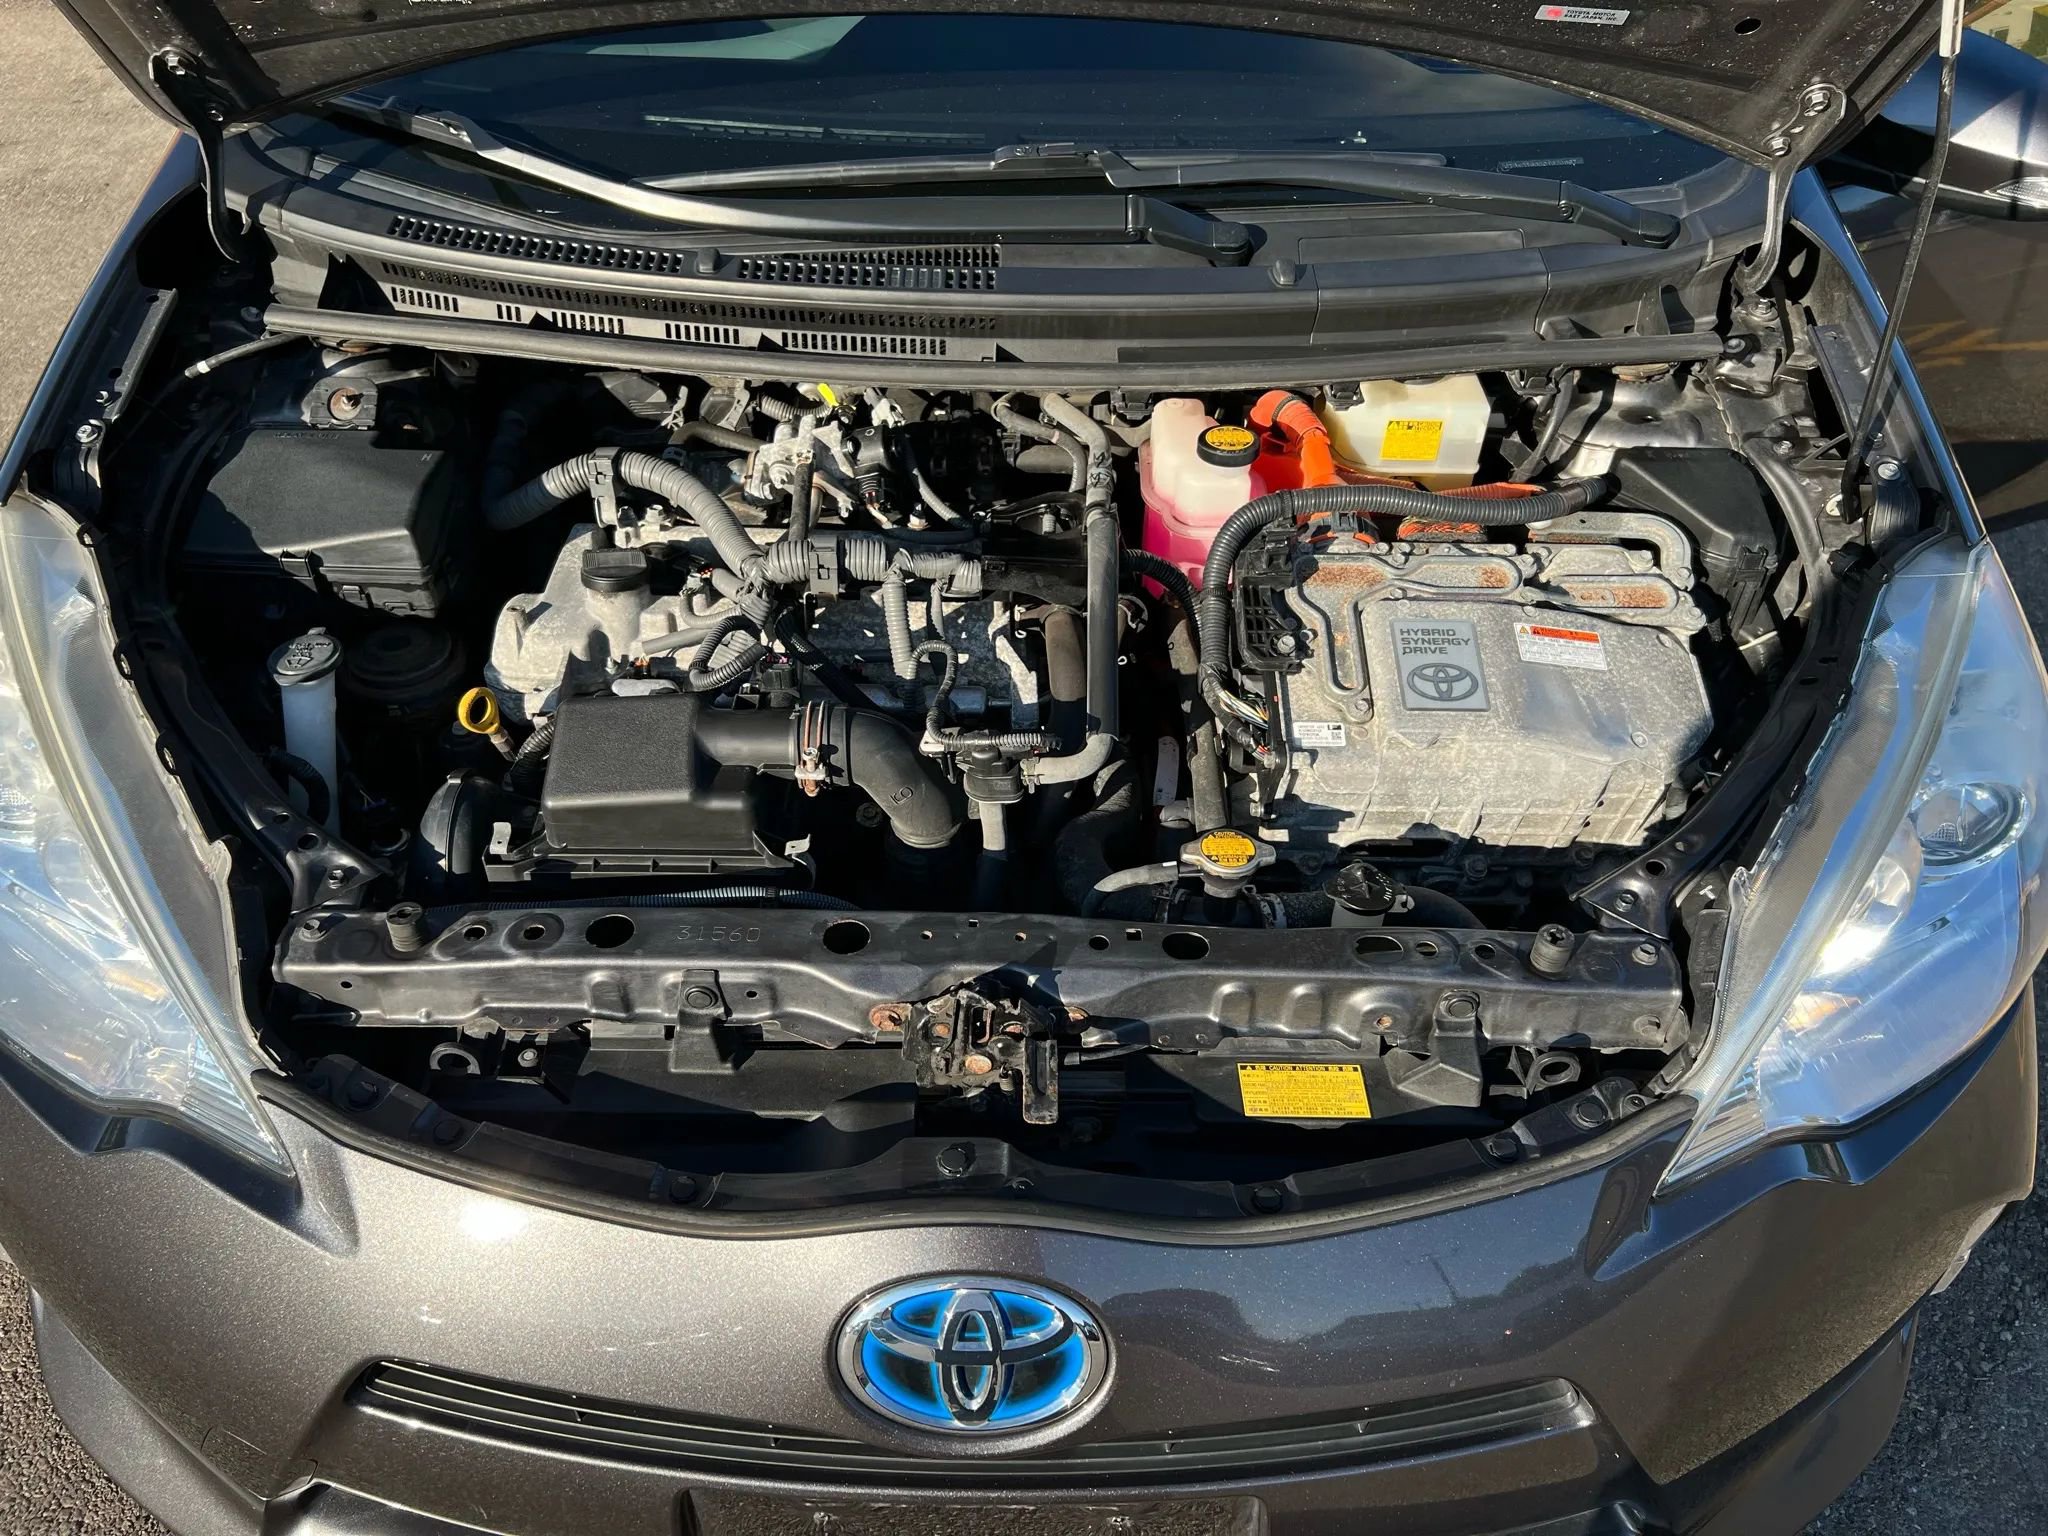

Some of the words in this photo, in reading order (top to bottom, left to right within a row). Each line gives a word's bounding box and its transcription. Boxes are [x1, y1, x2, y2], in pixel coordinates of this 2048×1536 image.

[1399, 628, 1456, 637] HYBRID
[1401, 637, 1471, 646] SYNERGY
[1402, 646, 1449, 655] DRIVE
[676, 925, 761, 942] 31560
